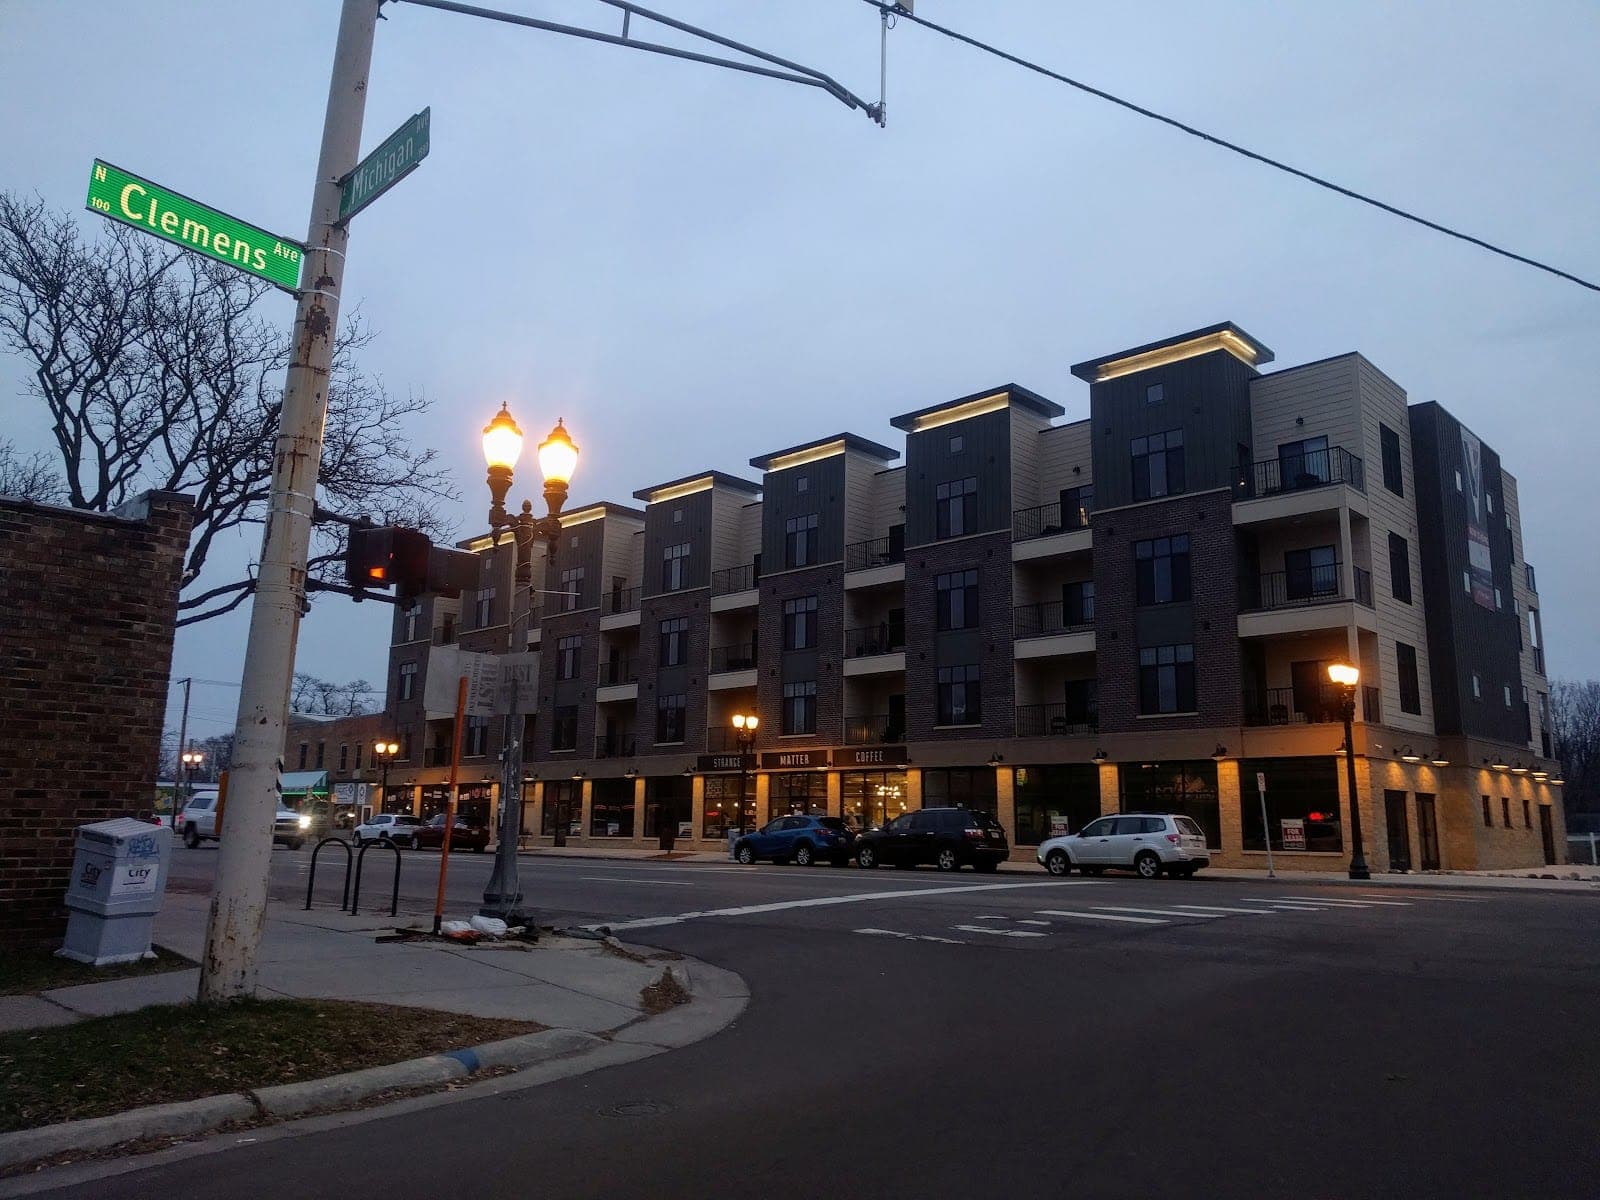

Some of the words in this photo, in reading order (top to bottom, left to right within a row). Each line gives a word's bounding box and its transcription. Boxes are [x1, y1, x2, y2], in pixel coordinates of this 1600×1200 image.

[95, 165, 107, 184] N
[351, 137, 413, 204] Michigan
[91, 196, 110, 212] 100
[120, 184, 267, 270] Clemens
[273, 242, 299, 263] Ave
[713, 757, 741, 769] STRANGE
[780, 754, 810, 766] MATTER
[855, 750, 884, 763] COFFEE
